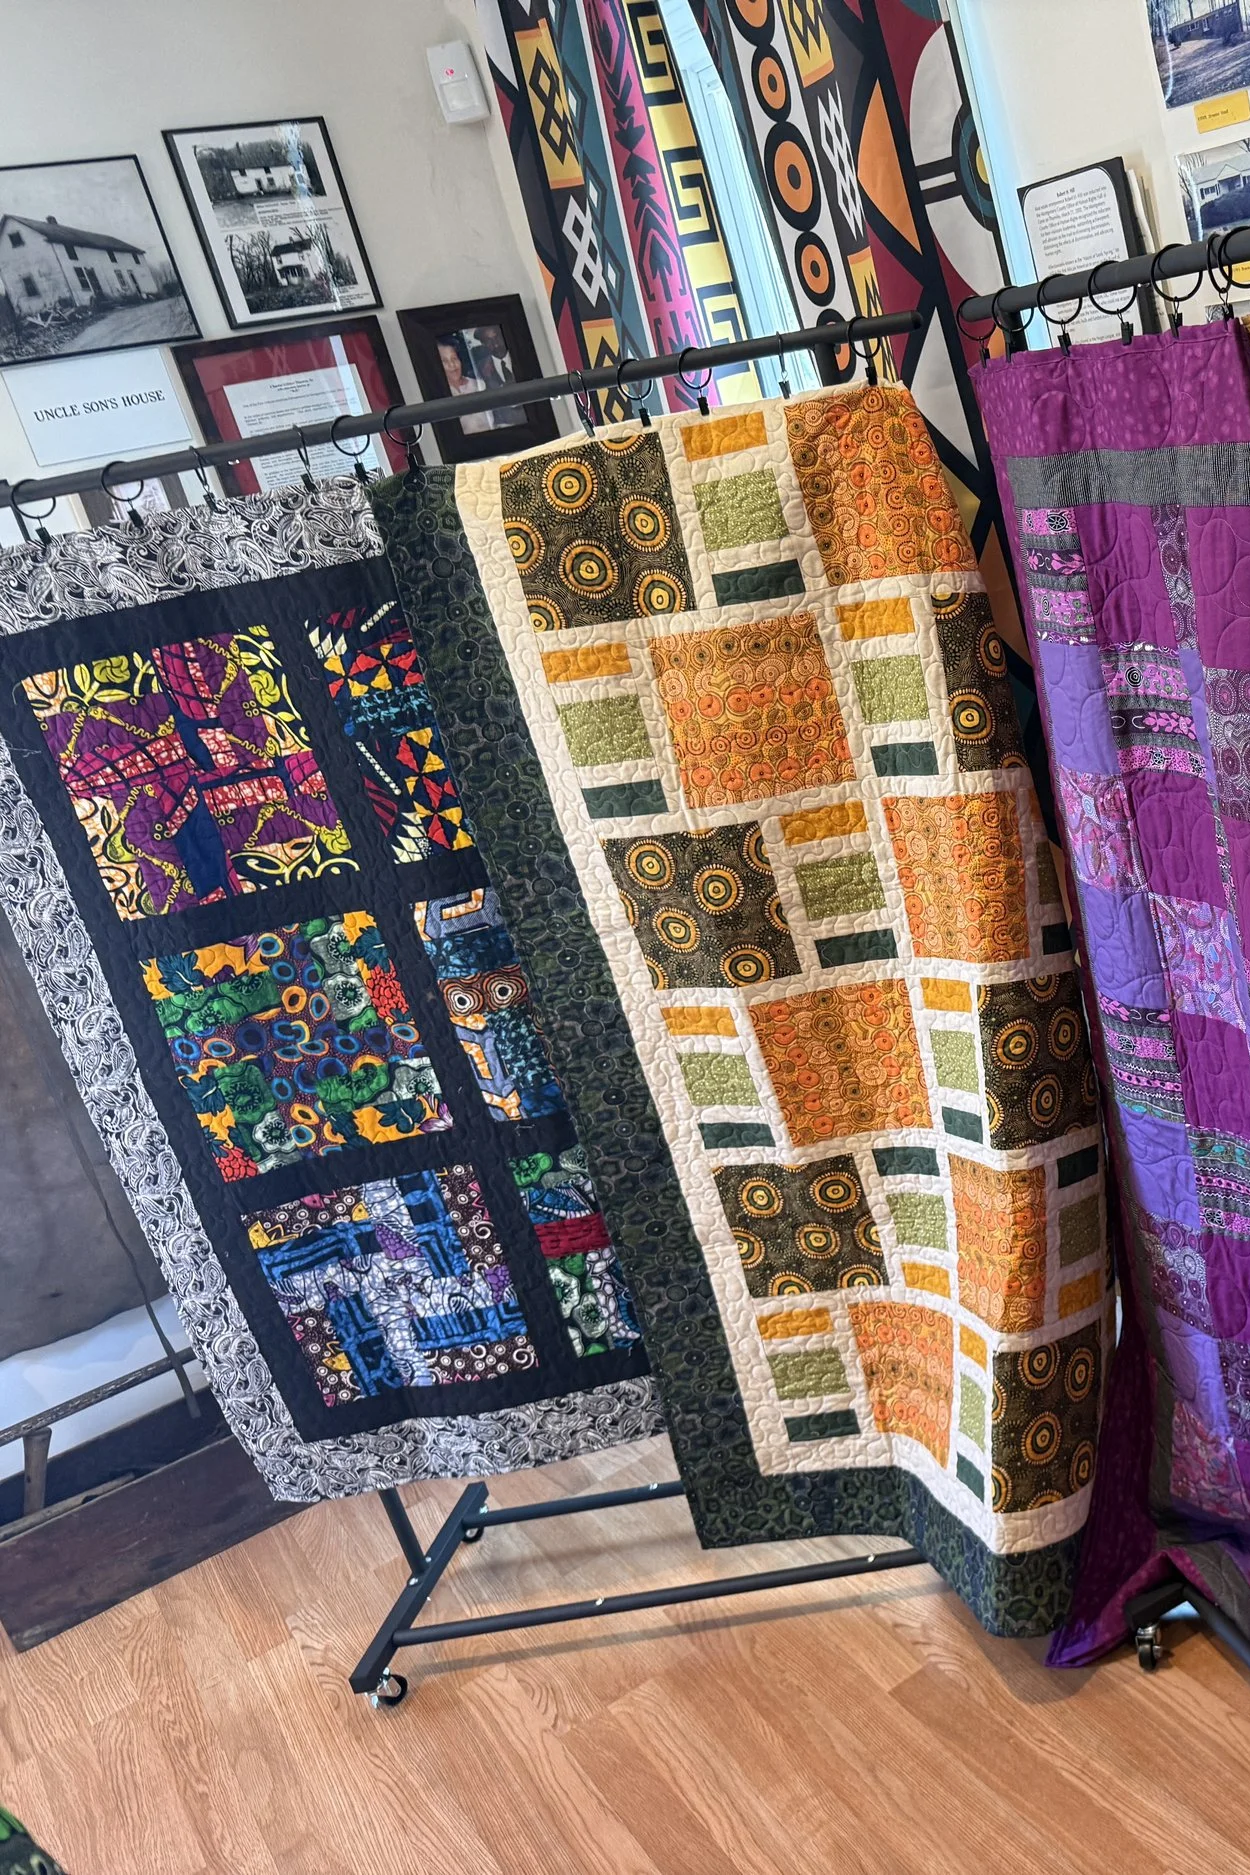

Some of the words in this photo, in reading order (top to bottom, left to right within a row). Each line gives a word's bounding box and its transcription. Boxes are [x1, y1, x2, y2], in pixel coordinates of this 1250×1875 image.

[34, 405, 80, 422] UNCLE
[83, 398, 118, 413] SON'S
[122, 390, 165, 407] HOUSE
